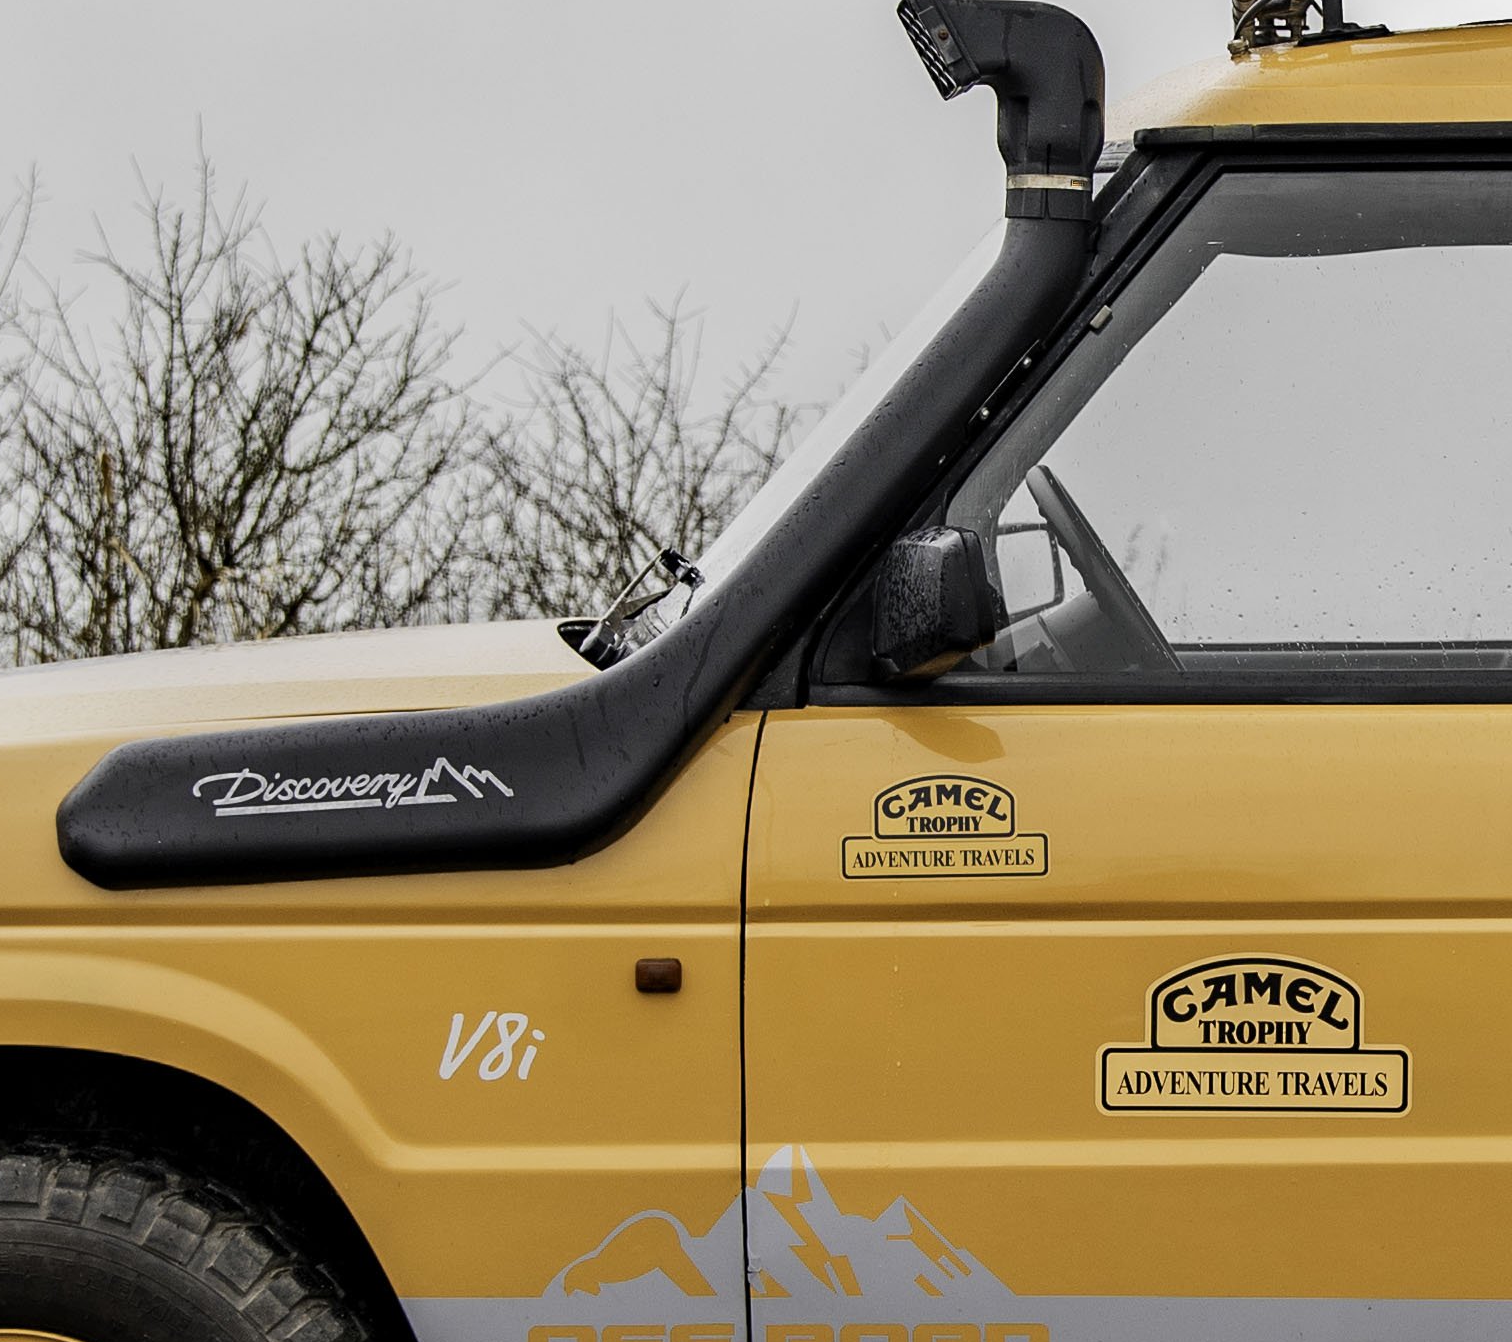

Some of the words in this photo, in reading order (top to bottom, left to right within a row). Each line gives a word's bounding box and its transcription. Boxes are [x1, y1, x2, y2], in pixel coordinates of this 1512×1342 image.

[193, 767, 419, 809] Discovery
[881, 784, 1008, 820] CAMEL
[906, 814, 983, 834] TROPHY
[852, 849, 956, 870] ADVENTURE
[958, 847, 1036, 868] TRAVELS
[1161, 972, 1350, 1032] CAMEL
[438, 1010, 546, 1082] V8i
[1198, 1019, 1313, 1046] TROPHY
[1116, 1070, 1271, 1097] ADVENTURE
[1277, 1070, 1388, 1098] TRAVELS
